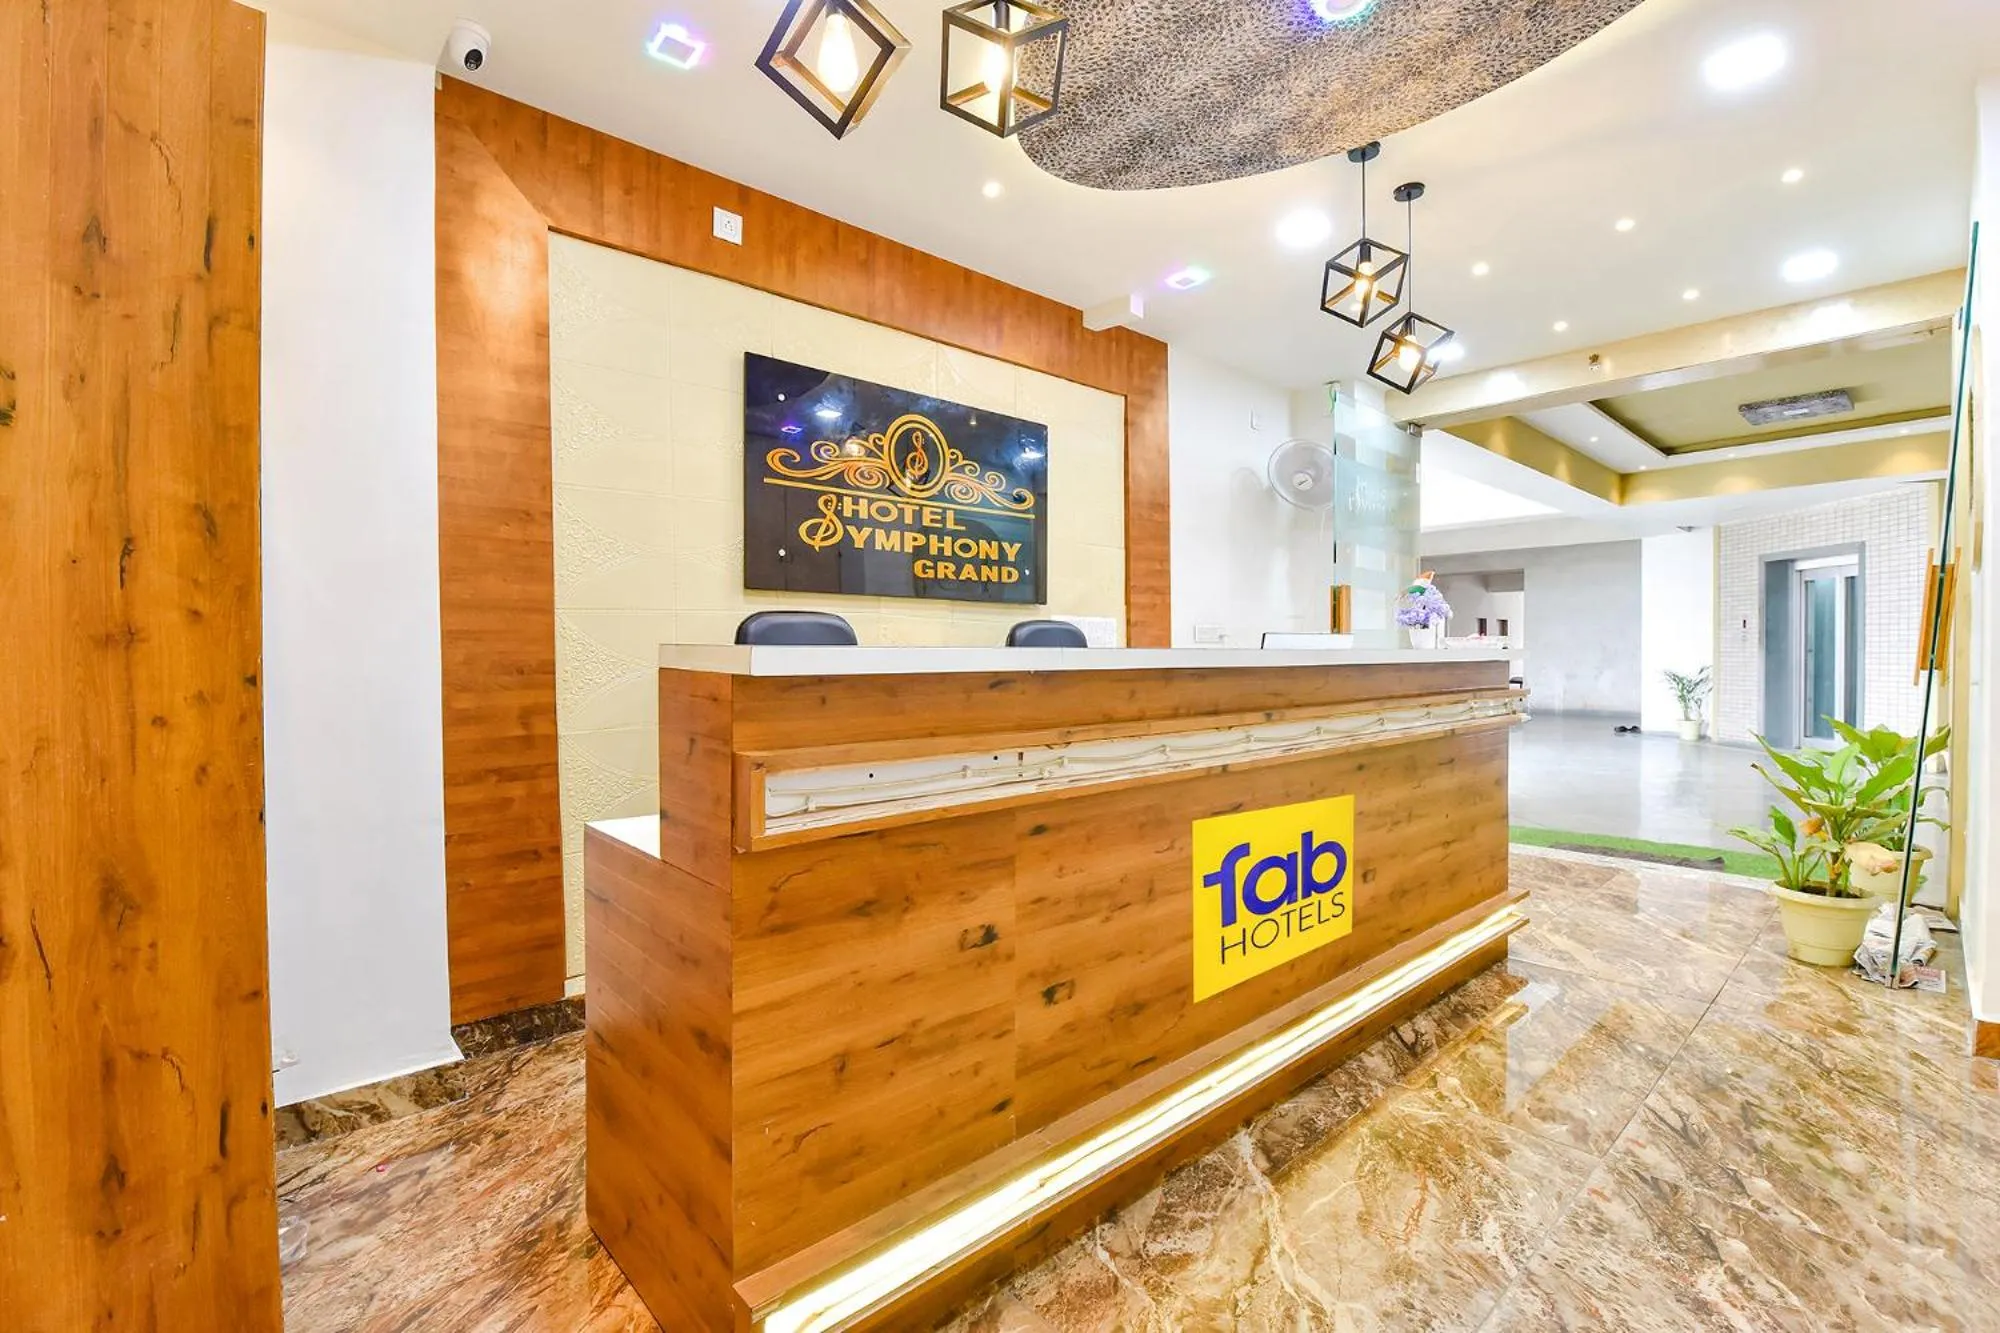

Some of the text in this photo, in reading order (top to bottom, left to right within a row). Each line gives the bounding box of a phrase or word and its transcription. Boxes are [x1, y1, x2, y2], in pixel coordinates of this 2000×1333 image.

[798, 493, 1022, 562] SYMPHONY
[842, 495, 966, 530] HOTEL
[913, 559, 1020, 583] GRAND
[1203, 831, 1348, 928] fab
[1221, 892, 1345, 965] HOTELS
